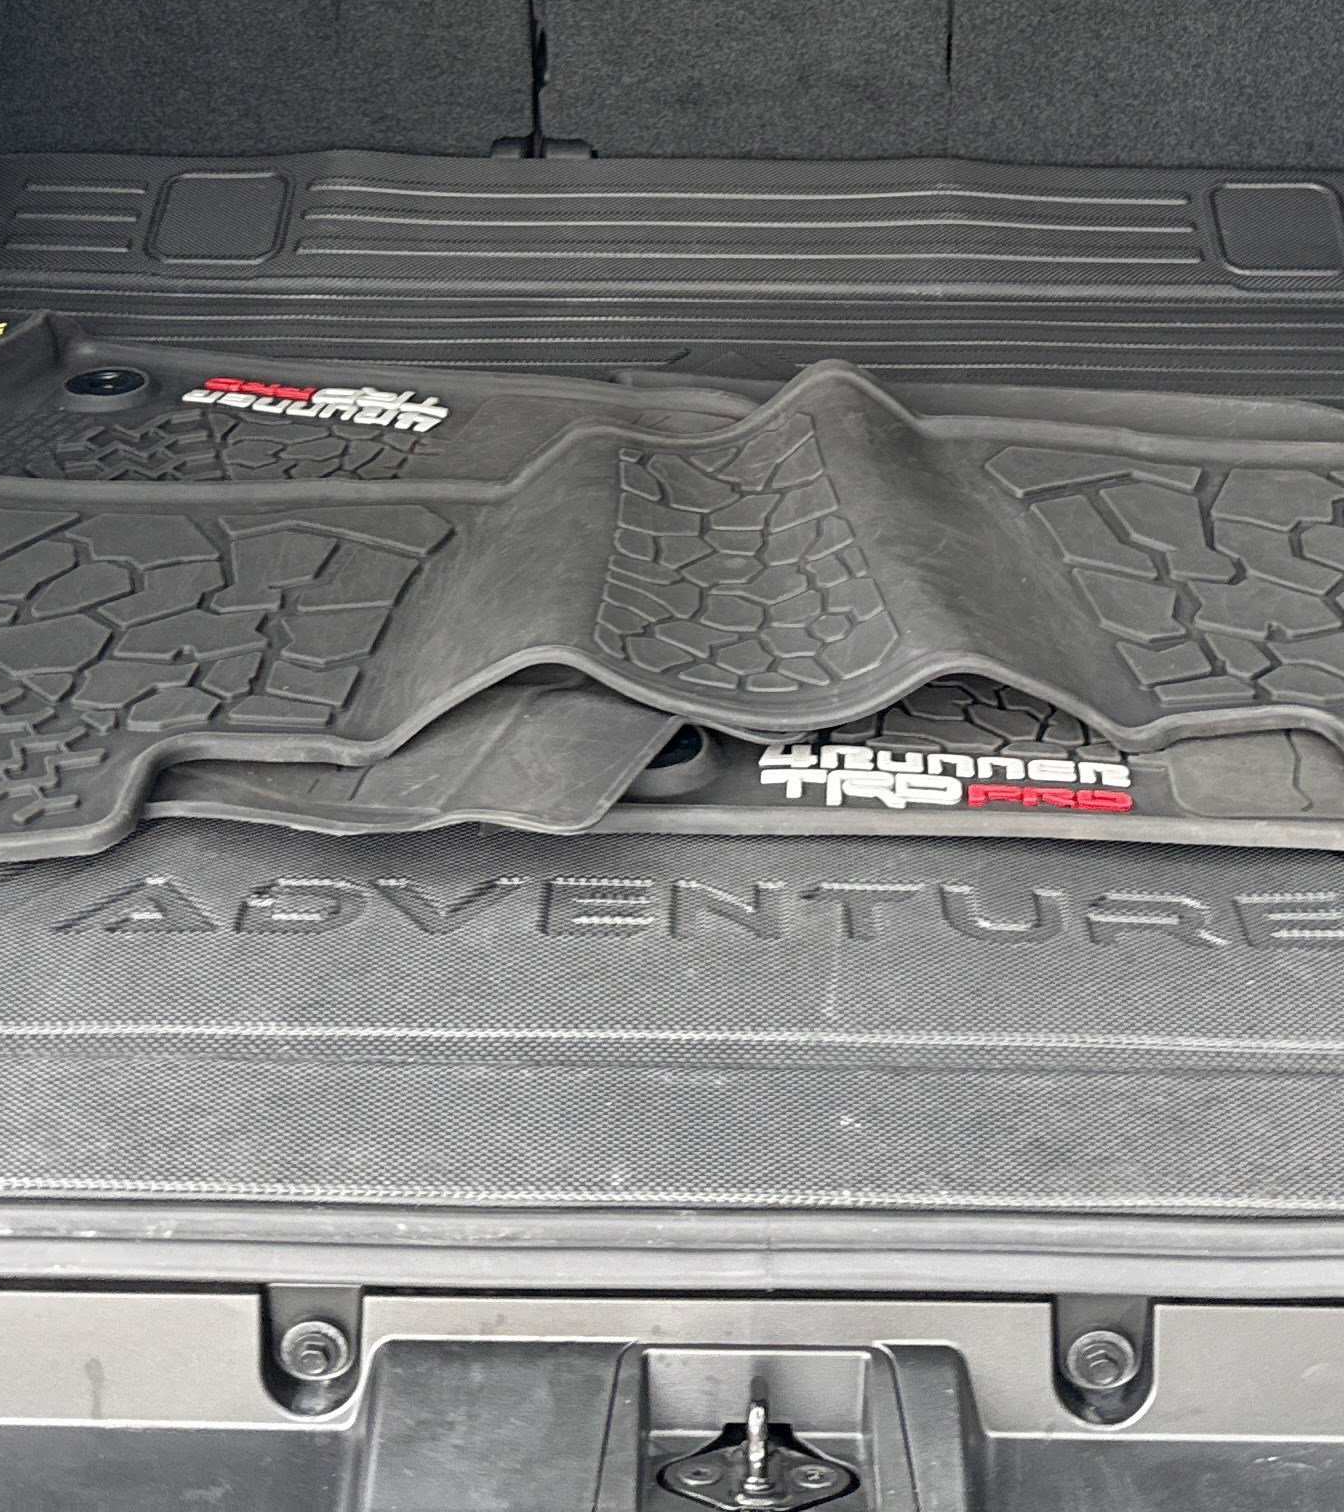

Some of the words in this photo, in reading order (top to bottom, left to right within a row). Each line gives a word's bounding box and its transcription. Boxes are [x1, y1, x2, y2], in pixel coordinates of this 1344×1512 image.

[204, 376, 317, 401] PRO
[312, 387, 448, 418] TRD
[760, 768, 963, 809] TRD
[967, 783, 1133, 812] PRO
